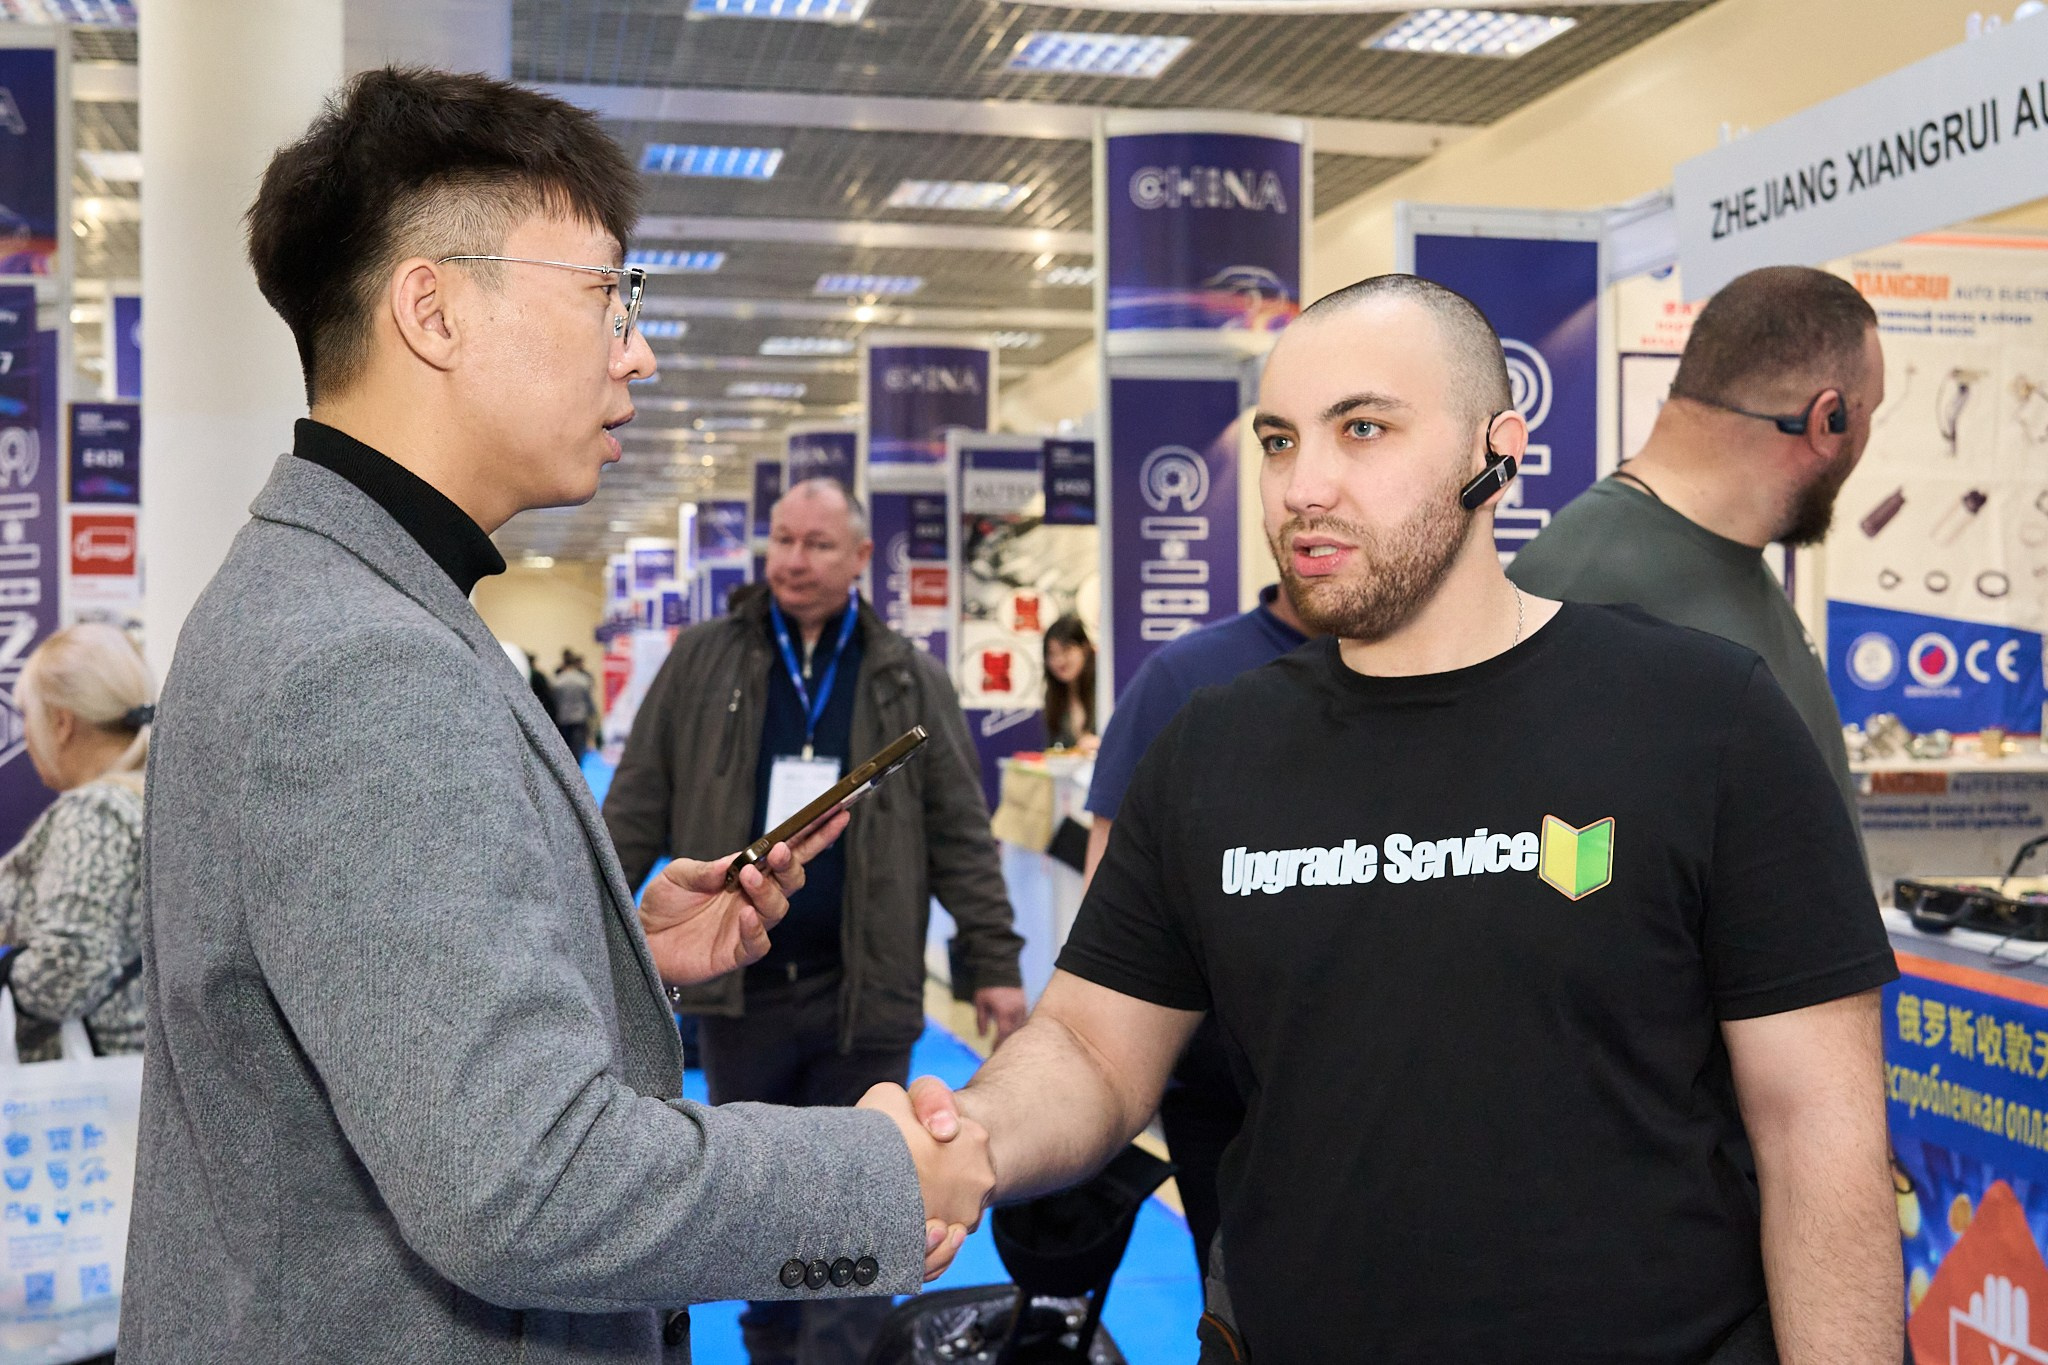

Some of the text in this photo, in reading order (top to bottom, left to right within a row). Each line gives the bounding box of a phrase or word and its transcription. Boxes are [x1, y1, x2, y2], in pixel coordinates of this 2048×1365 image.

[1129, 165, 1288, 214] CHINA
[1711, 160, 1837, 240] ZHEJIANG
[1848, 98, 2000, 194] XIANGRUI
[1222, 827, 1540, 896] Upgrade Service
